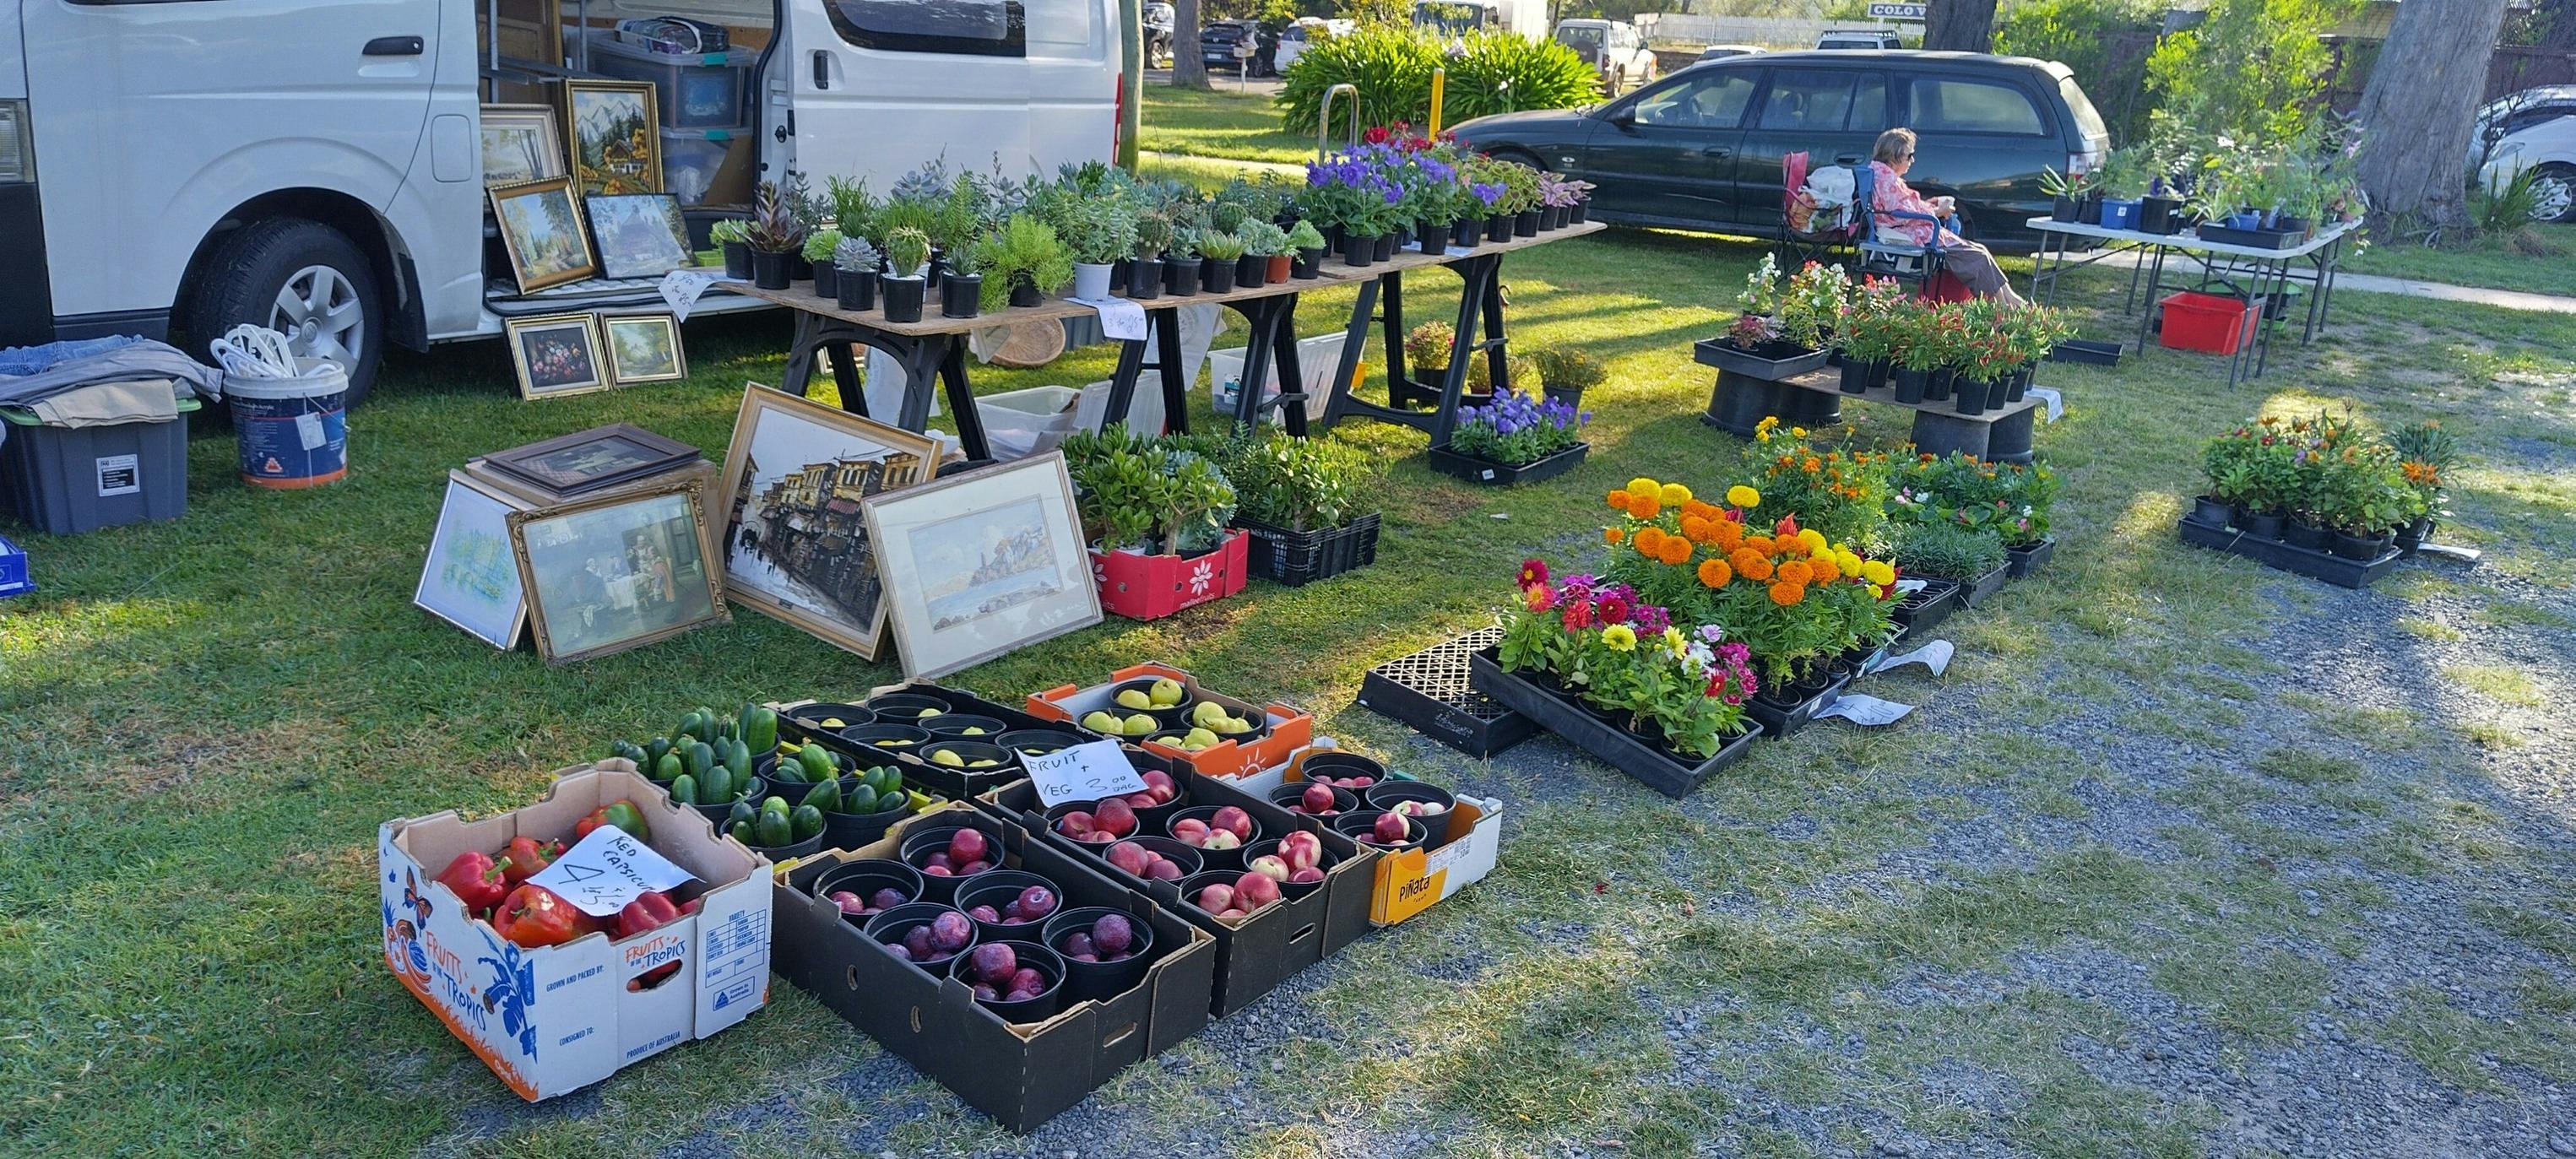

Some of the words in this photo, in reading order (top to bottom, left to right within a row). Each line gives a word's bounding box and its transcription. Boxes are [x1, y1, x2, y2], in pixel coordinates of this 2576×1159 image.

[1874, 5, 1914, 15] COLO
[1917, 7, 1927, 16] V
[1027, 750, 1080, 772] FRUIT
[1039, 783, 1072, 797] VEG
[607, 836, 637, 857] RED
[426, 930, 462, 984] FRUITS
[626, 935, 664, 964] FRUITS
[643, 940, 686, 967] TROPICS
[546, 978, 566, 993] GROWN
[566, 973, 577, 985] AND
[578, 967, 596, 980] PACKED
[443, 972, 485, 1032] TROPICS
[559, 1030, 586, 1047] CONSIGNED
[626, 1043, 648, 1059] PRODUCE
[648, 1040, 655, 1050] OF
[656, 1031, 681, 1046] AUSTRALIA
